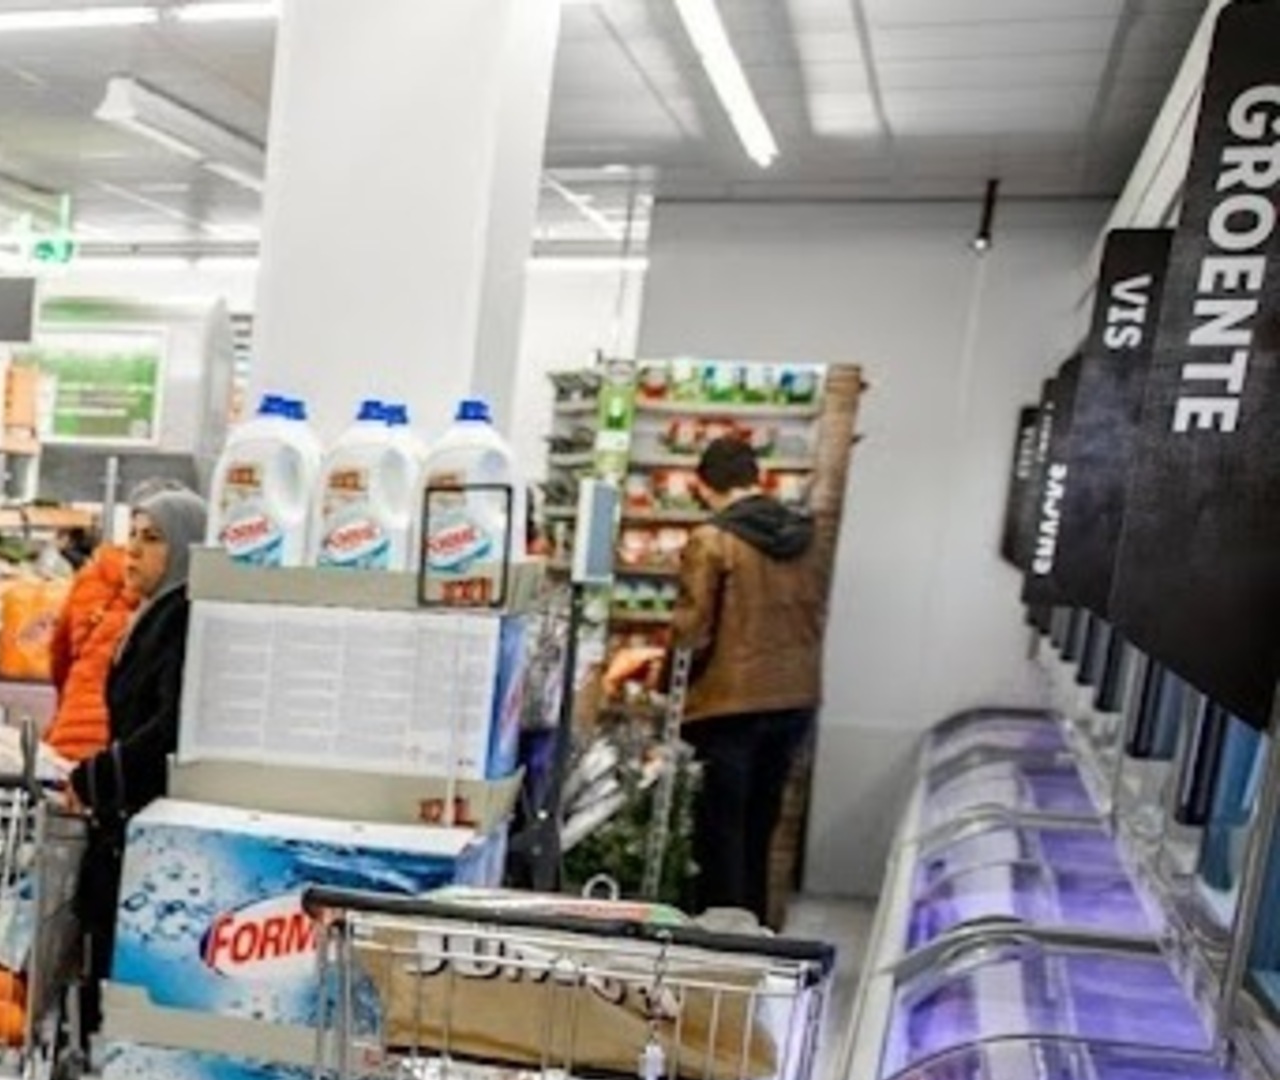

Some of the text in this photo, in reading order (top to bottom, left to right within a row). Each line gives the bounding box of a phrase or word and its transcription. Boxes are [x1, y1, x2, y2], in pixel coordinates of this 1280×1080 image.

[1172, 84, 1280, 433] GROENTE
[1103, 274, 1153, 350] VIS
[208, 908, 332, 968] FORM
